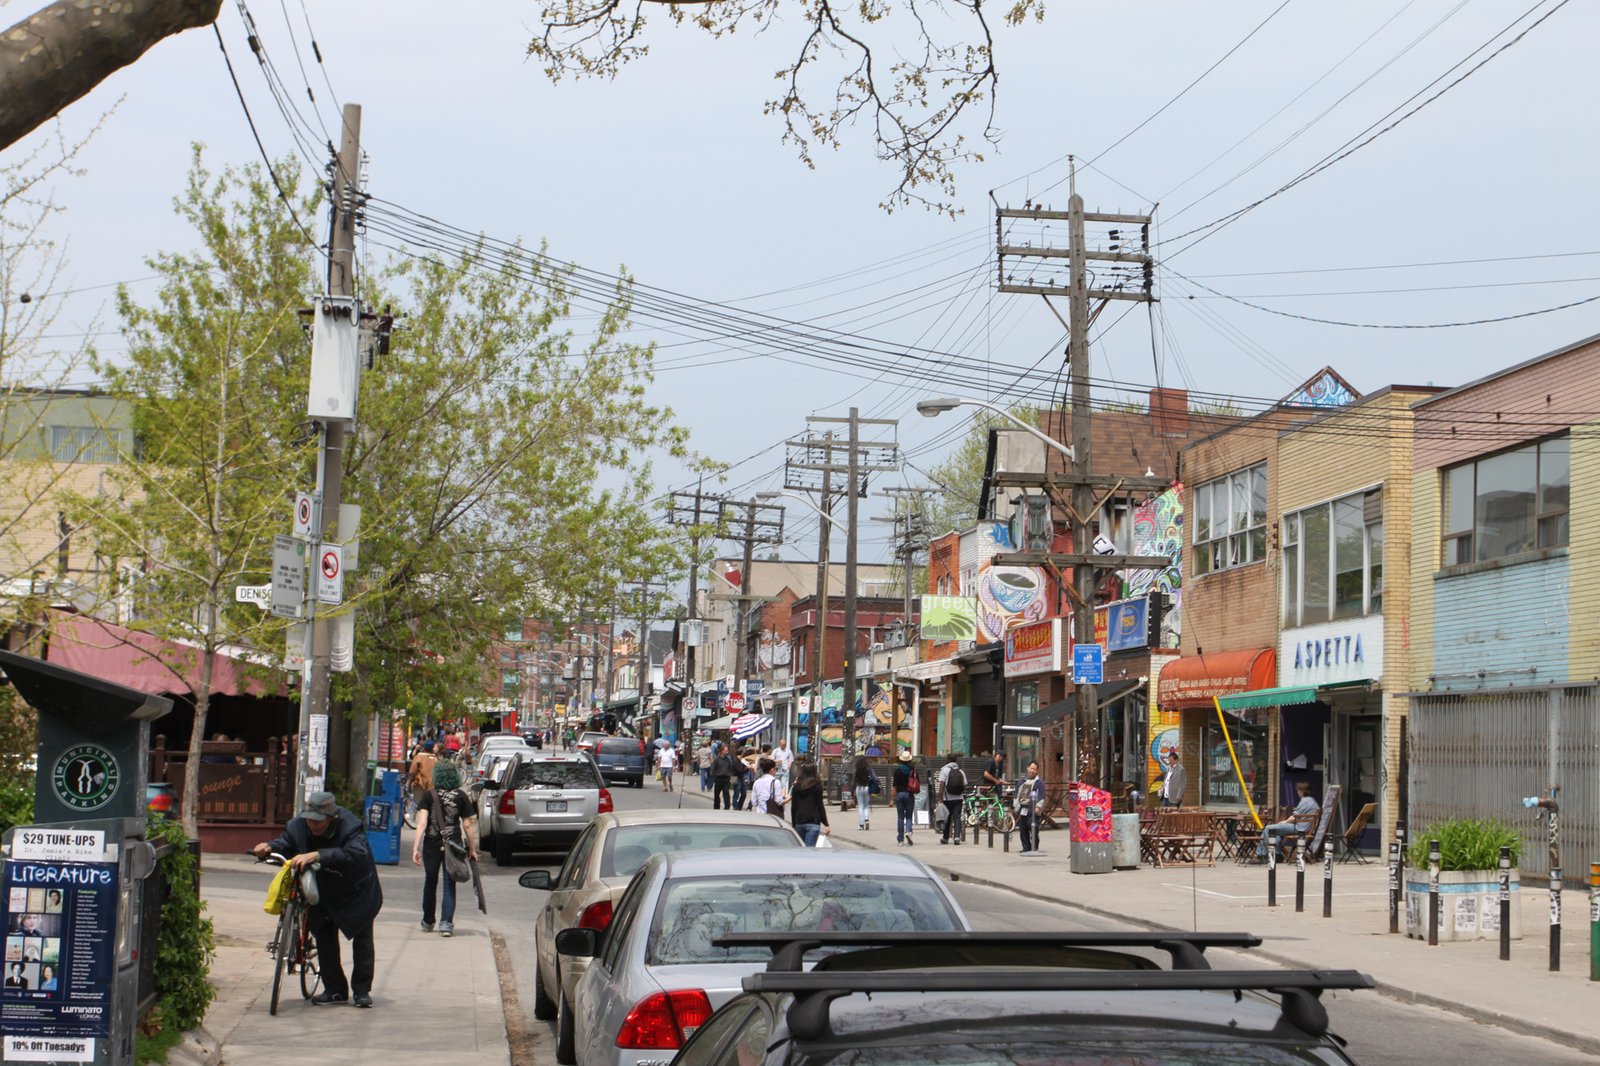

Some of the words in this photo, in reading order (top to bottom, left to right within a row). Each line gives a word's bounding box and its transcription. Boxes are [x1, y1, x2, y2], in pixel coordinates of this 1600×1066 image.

[922, 596, 975, 613] green
[1294, 632, 1365, 669] ASPETTA
[725, 698, 744, 708] STOP
[56, 747, 116, 774] MUNICIPAL
[56, 781, 115, 807] PARKING
[202, 775, 241, 795] ounge
[23, 833, 43, 845] $29
[47, 834, 95, 846] TUNE-UPS
[12, 1041, 28, 1050] 10%
[31, 1042, 42, 1050] Off
[44, 1042, 85, 1053] Tuesadys
